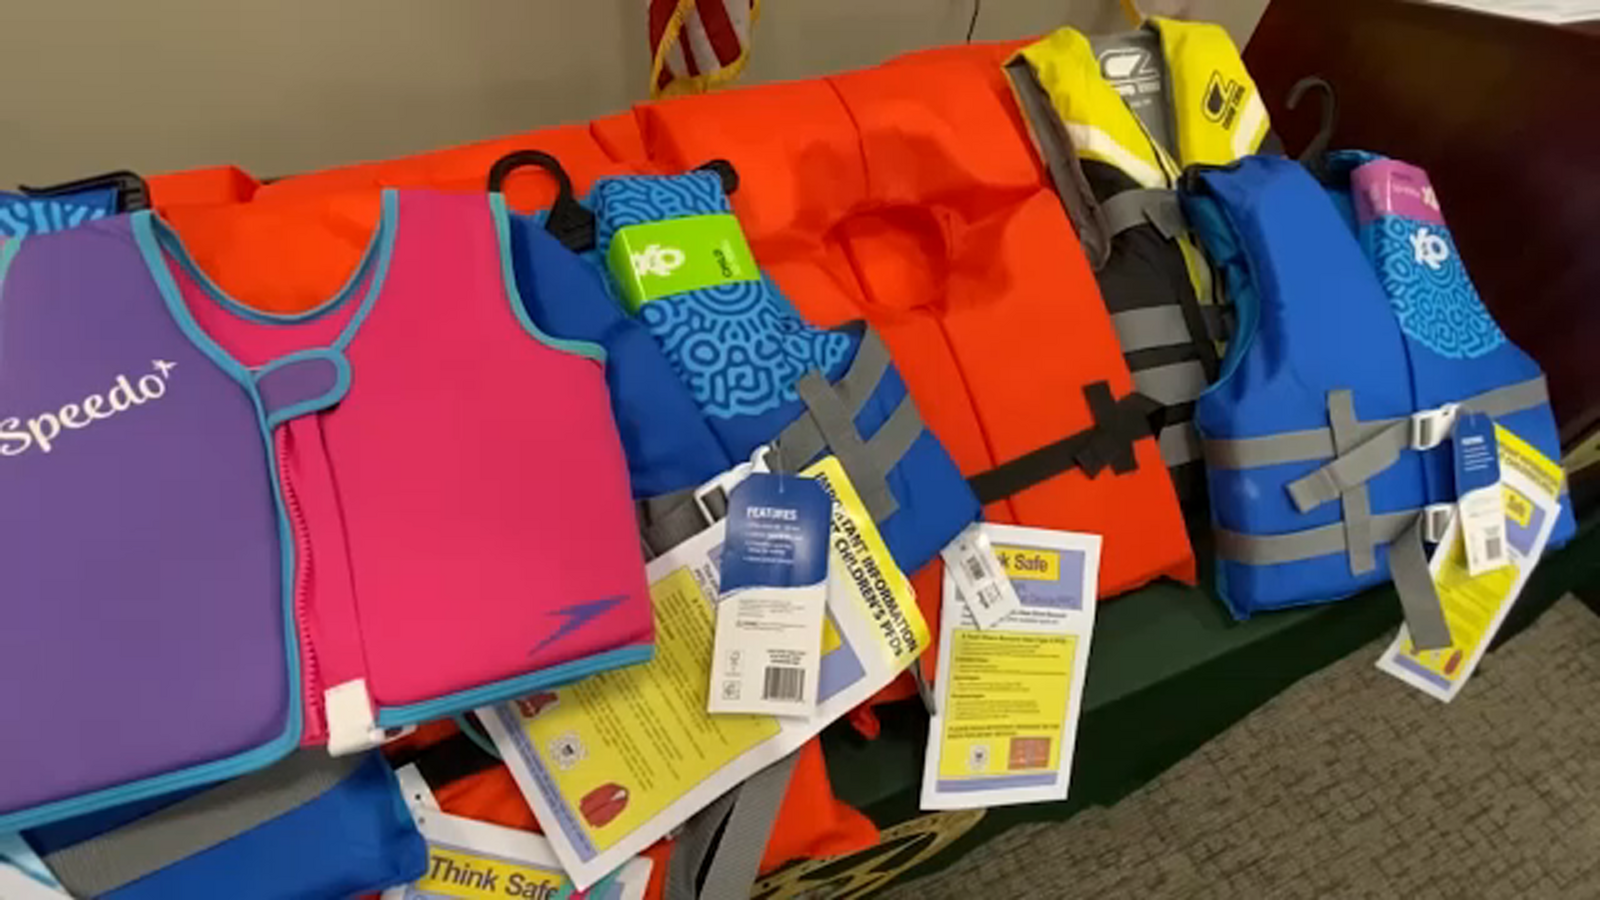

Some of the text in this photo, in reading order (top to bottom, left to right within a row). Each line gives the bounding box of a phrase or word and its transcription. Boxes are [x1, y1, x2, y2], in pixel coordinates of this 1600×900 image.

[0, 373, 165, 456] Speedo
[746, 506, 798, 521] FEATURES
[834, 537, 886, 621] CHILDREN'S
[1014, 552, 1049, 573] Safe
[861, 556, 919, 653] INFORMATION
[432, 855, 499, 892] Think
